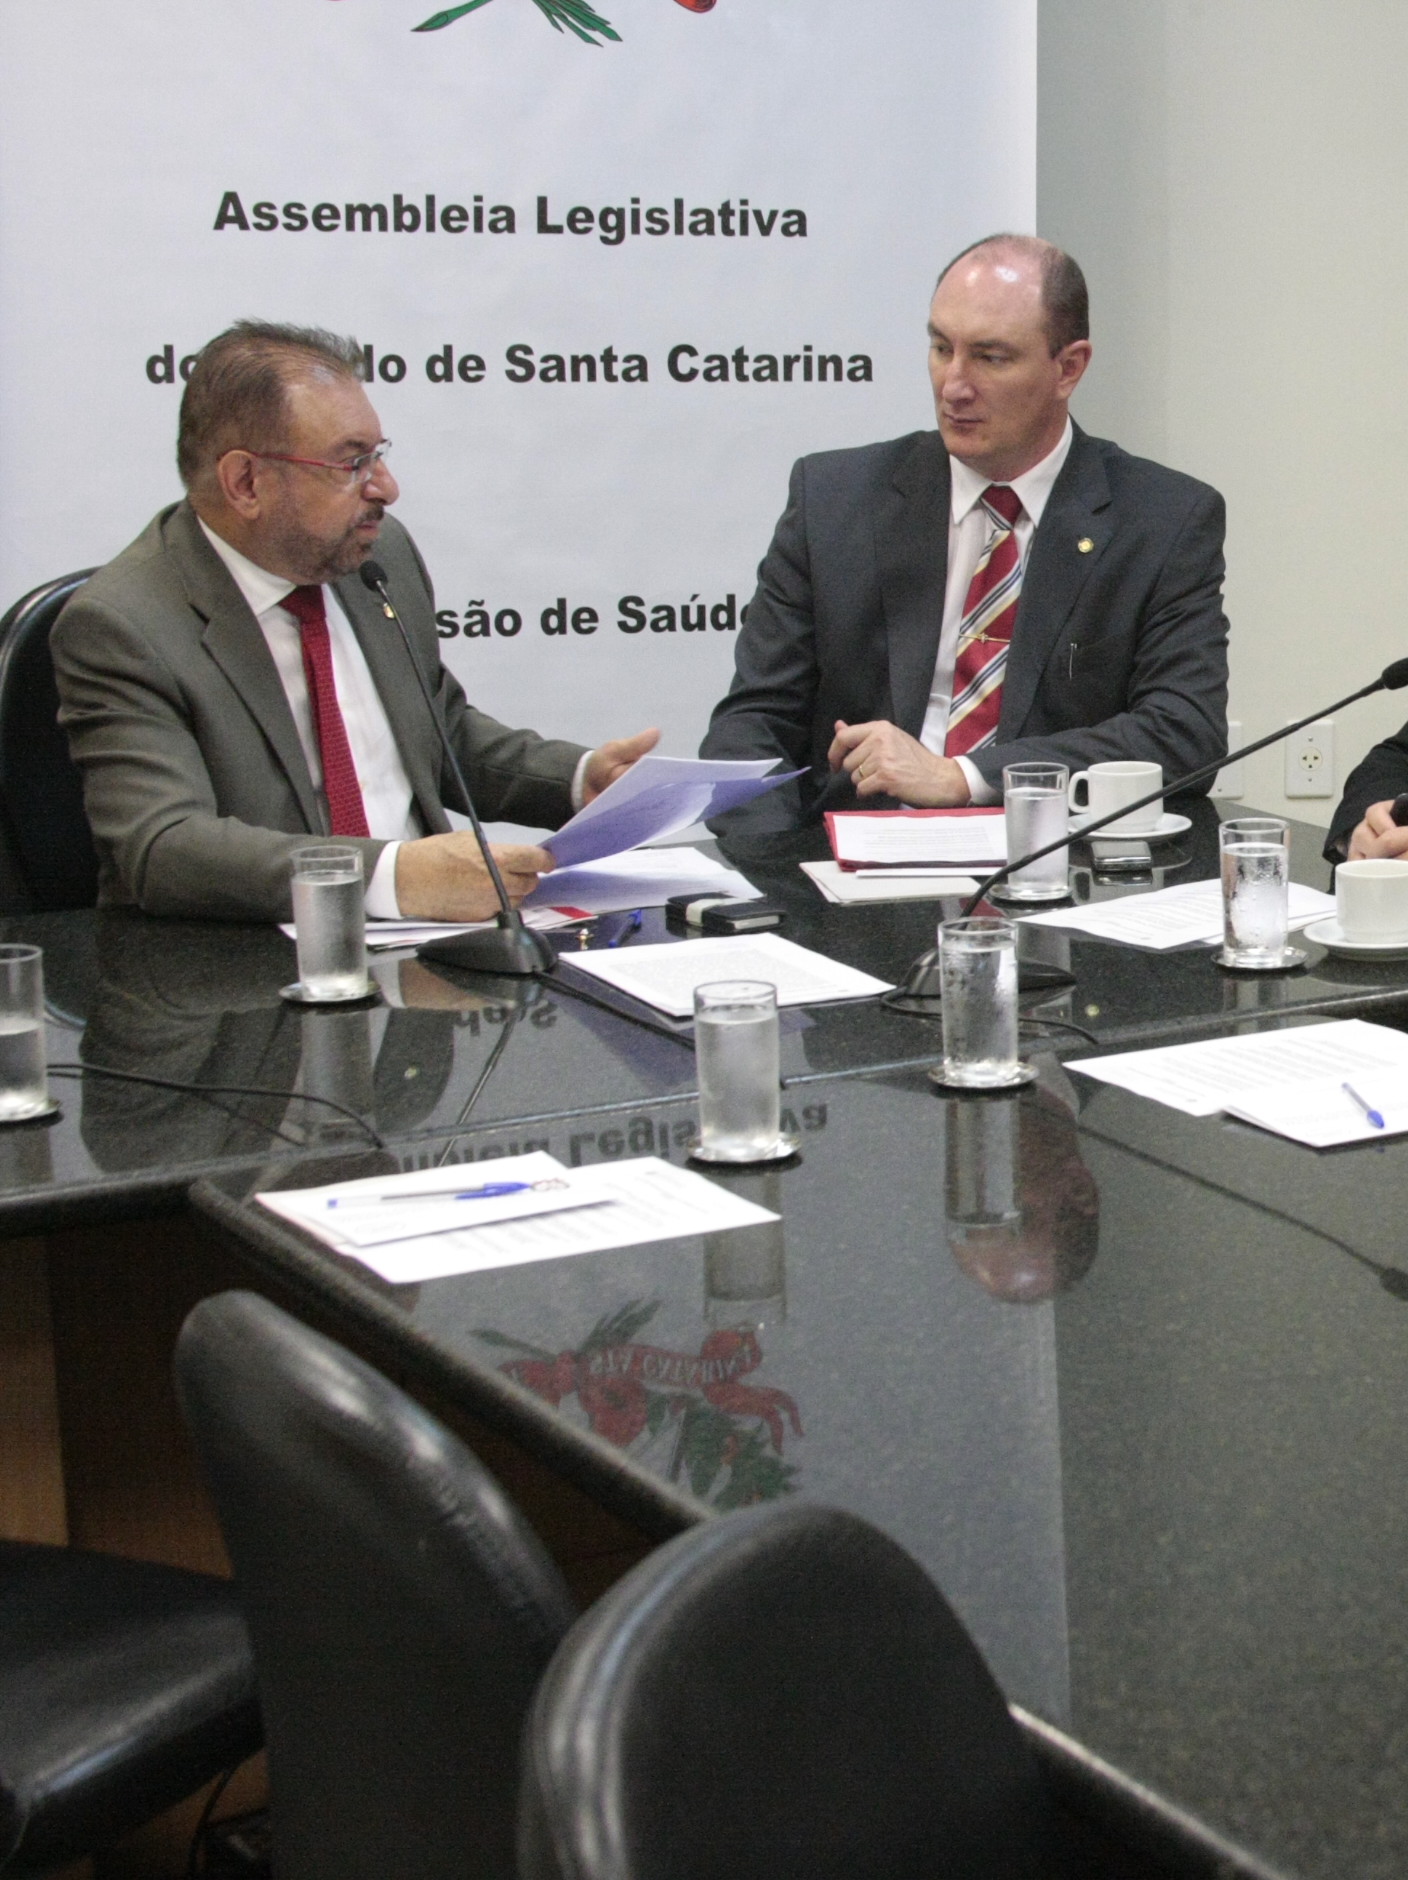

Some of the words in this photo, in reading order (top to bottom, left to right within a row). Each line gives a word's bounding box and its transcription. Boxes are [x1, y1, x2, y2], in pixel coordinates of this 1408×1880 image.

[213, 191, 517, 234] Assembleia
[536, 195, 808, 246] Legislativa
[425, 344, 487, 383] de
[505, 344, 649, 383] Santa
[667, 344, 873, 383] Catarina
[540, 597, 599, 636] de
